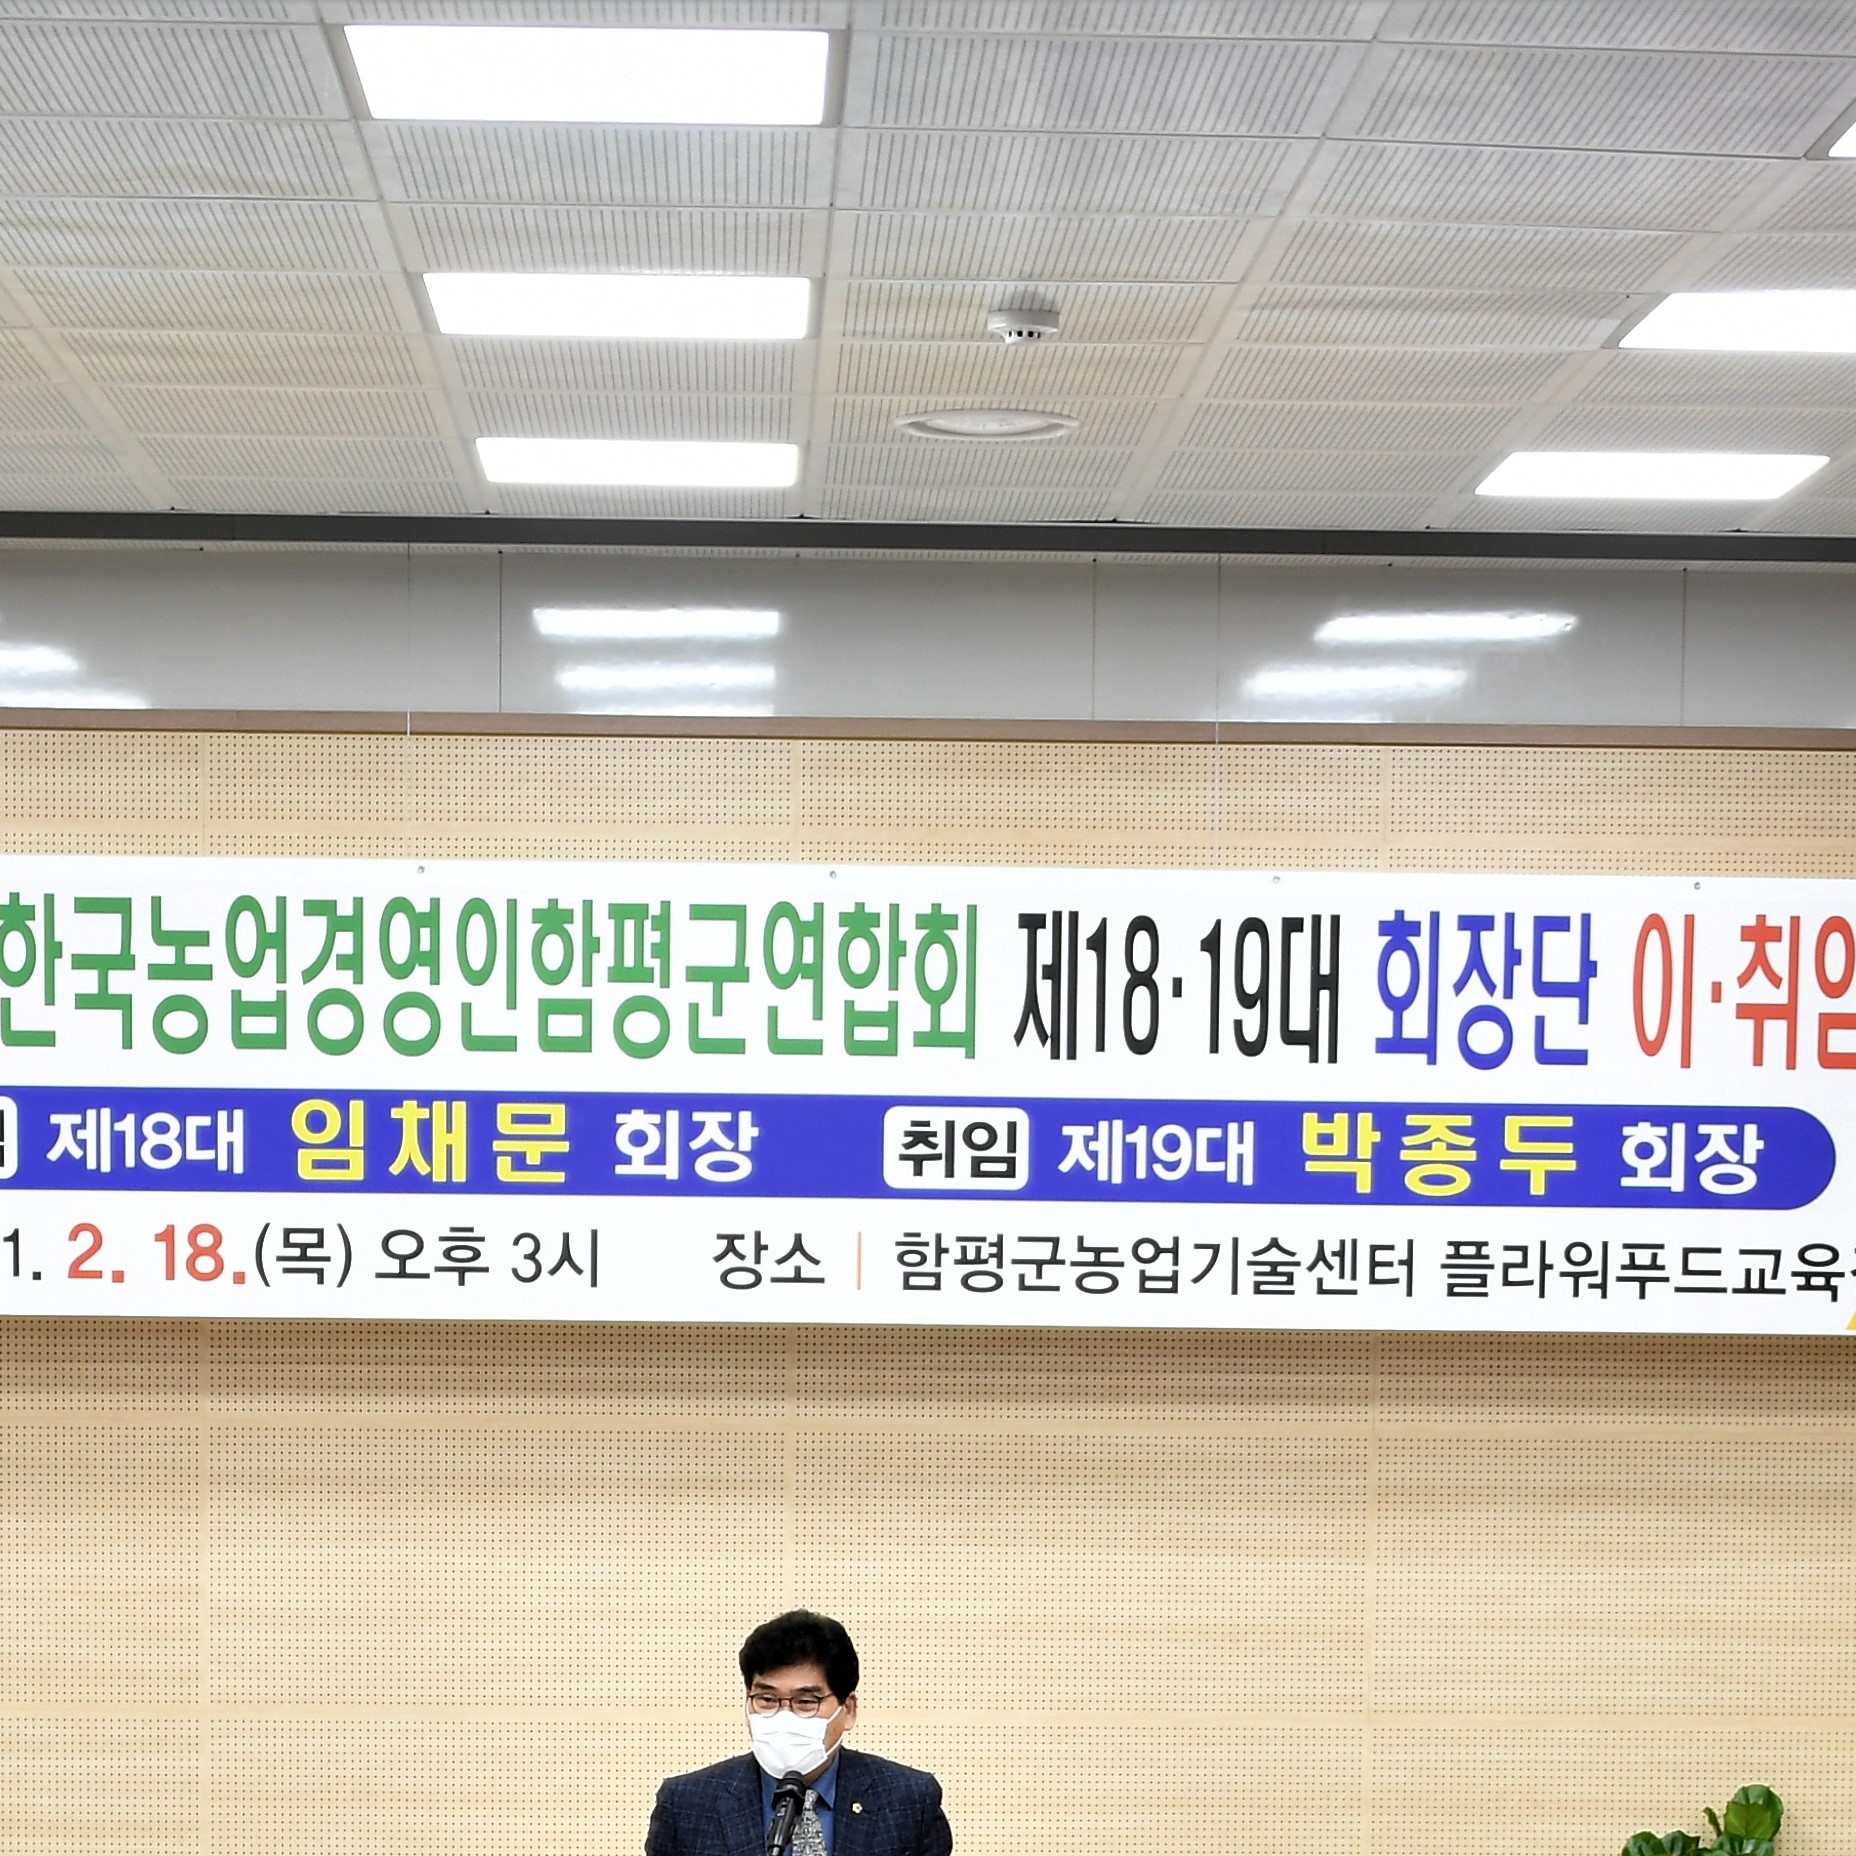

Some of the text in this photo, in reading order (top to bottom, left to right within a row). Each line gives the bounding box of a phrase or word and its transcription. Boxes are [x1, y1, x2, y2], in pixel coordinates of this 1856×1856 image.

[1013, 910, 1341, 1065] 제18·19대
[1375, 909, 1598, 1071] 회장단
[46, 1107, 244, 1174] 제18대
[614, 1108, 760, 1183] 회장
[899, 1120, 1017, 1179] 취임
[1057, 1119, 1255, 1186] 제19대
[1620, 1121, 1765, 1195] 회장
[67, 1222, 125, 1283] 2.
[374, 1226, 490, 1287] 오후
[511, 1228, 598, 1288] 3시
[712, 1230, 825, 1290] 장소
[894, 1232, 1414, 1298] 함평군농업기술센터
